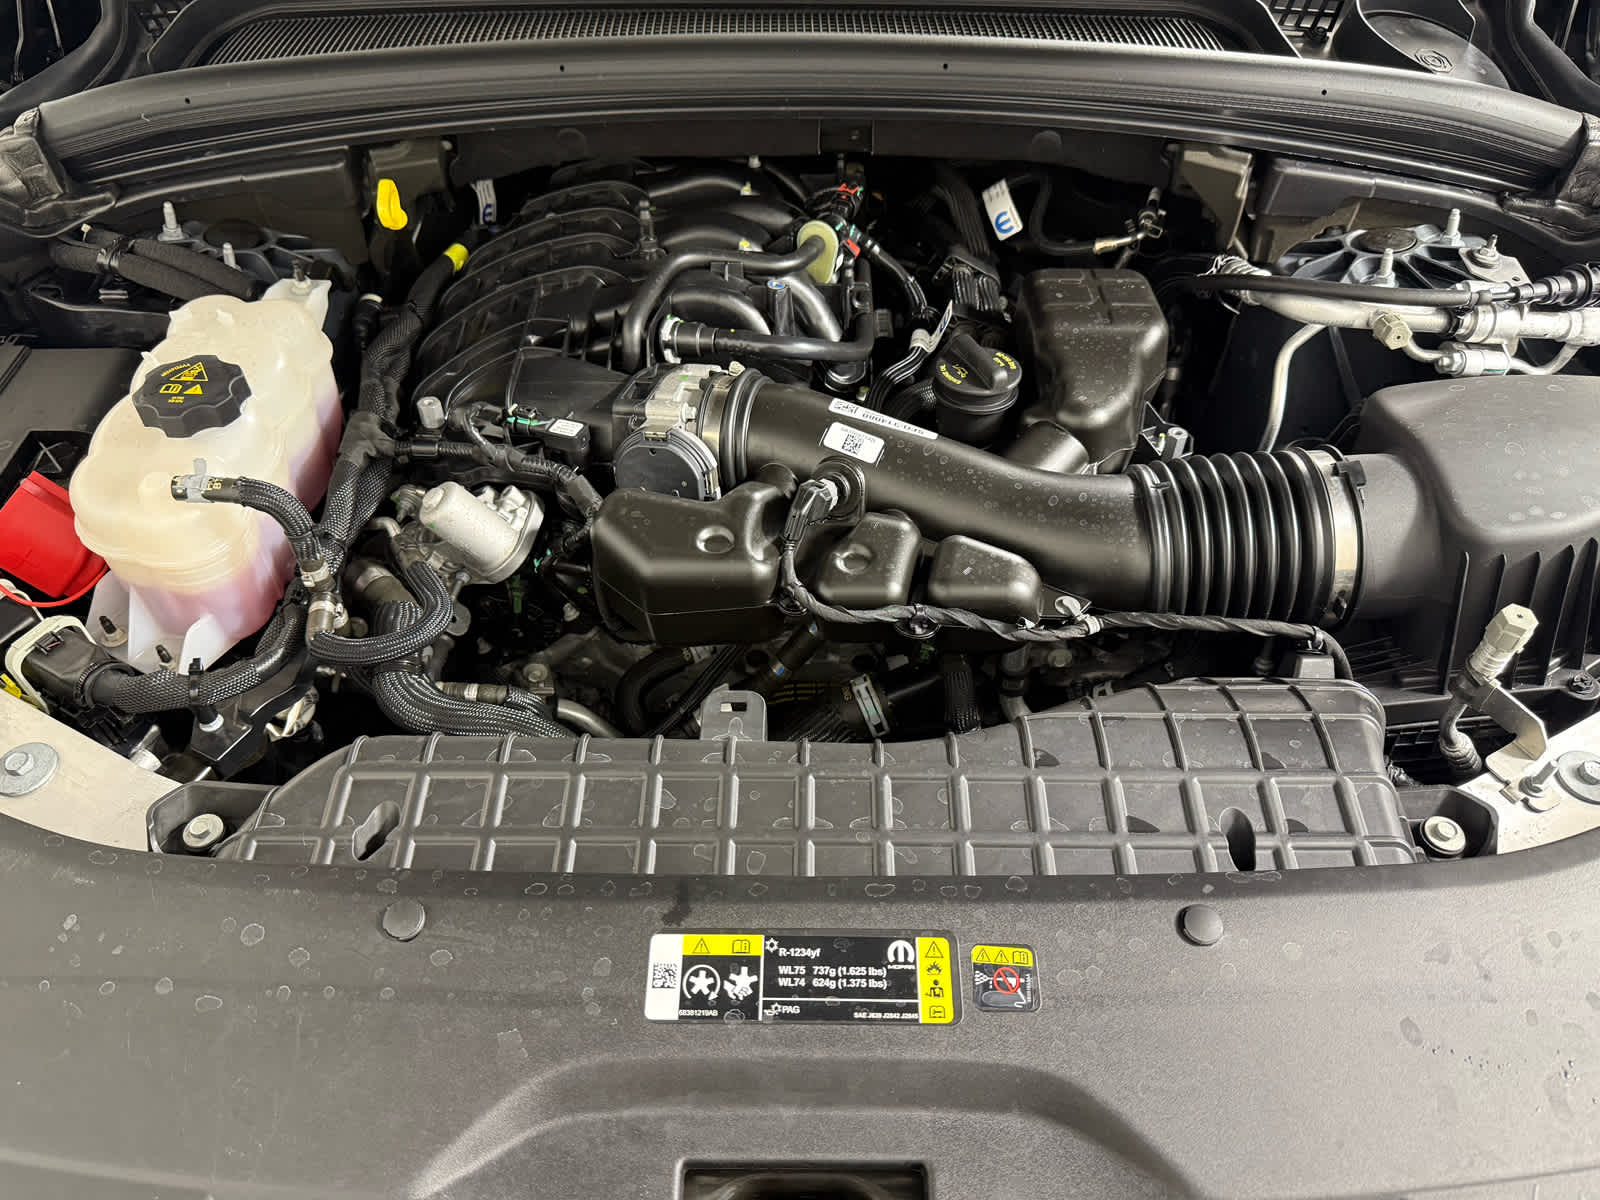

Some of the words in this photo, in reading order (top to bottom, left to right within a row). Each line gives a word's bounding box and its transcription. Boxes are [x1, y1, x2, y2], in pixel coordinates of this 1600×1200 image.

[779, 947, 821, 959] R-1234yf
[778, 966, 806, 975] WL75
[812, 966, 837, 977] 737g
[838, 966, 867, 978] (1.625
[868, 966, 887, 978] lbs)
[778, 977, 806, 987] WL74
[812, 978, 837, 989] 624g
[838, 978, 867, 989] (1.375
[868, 978, 888, 990] lbs)
[782, 1005, 801, 1014] PAG
